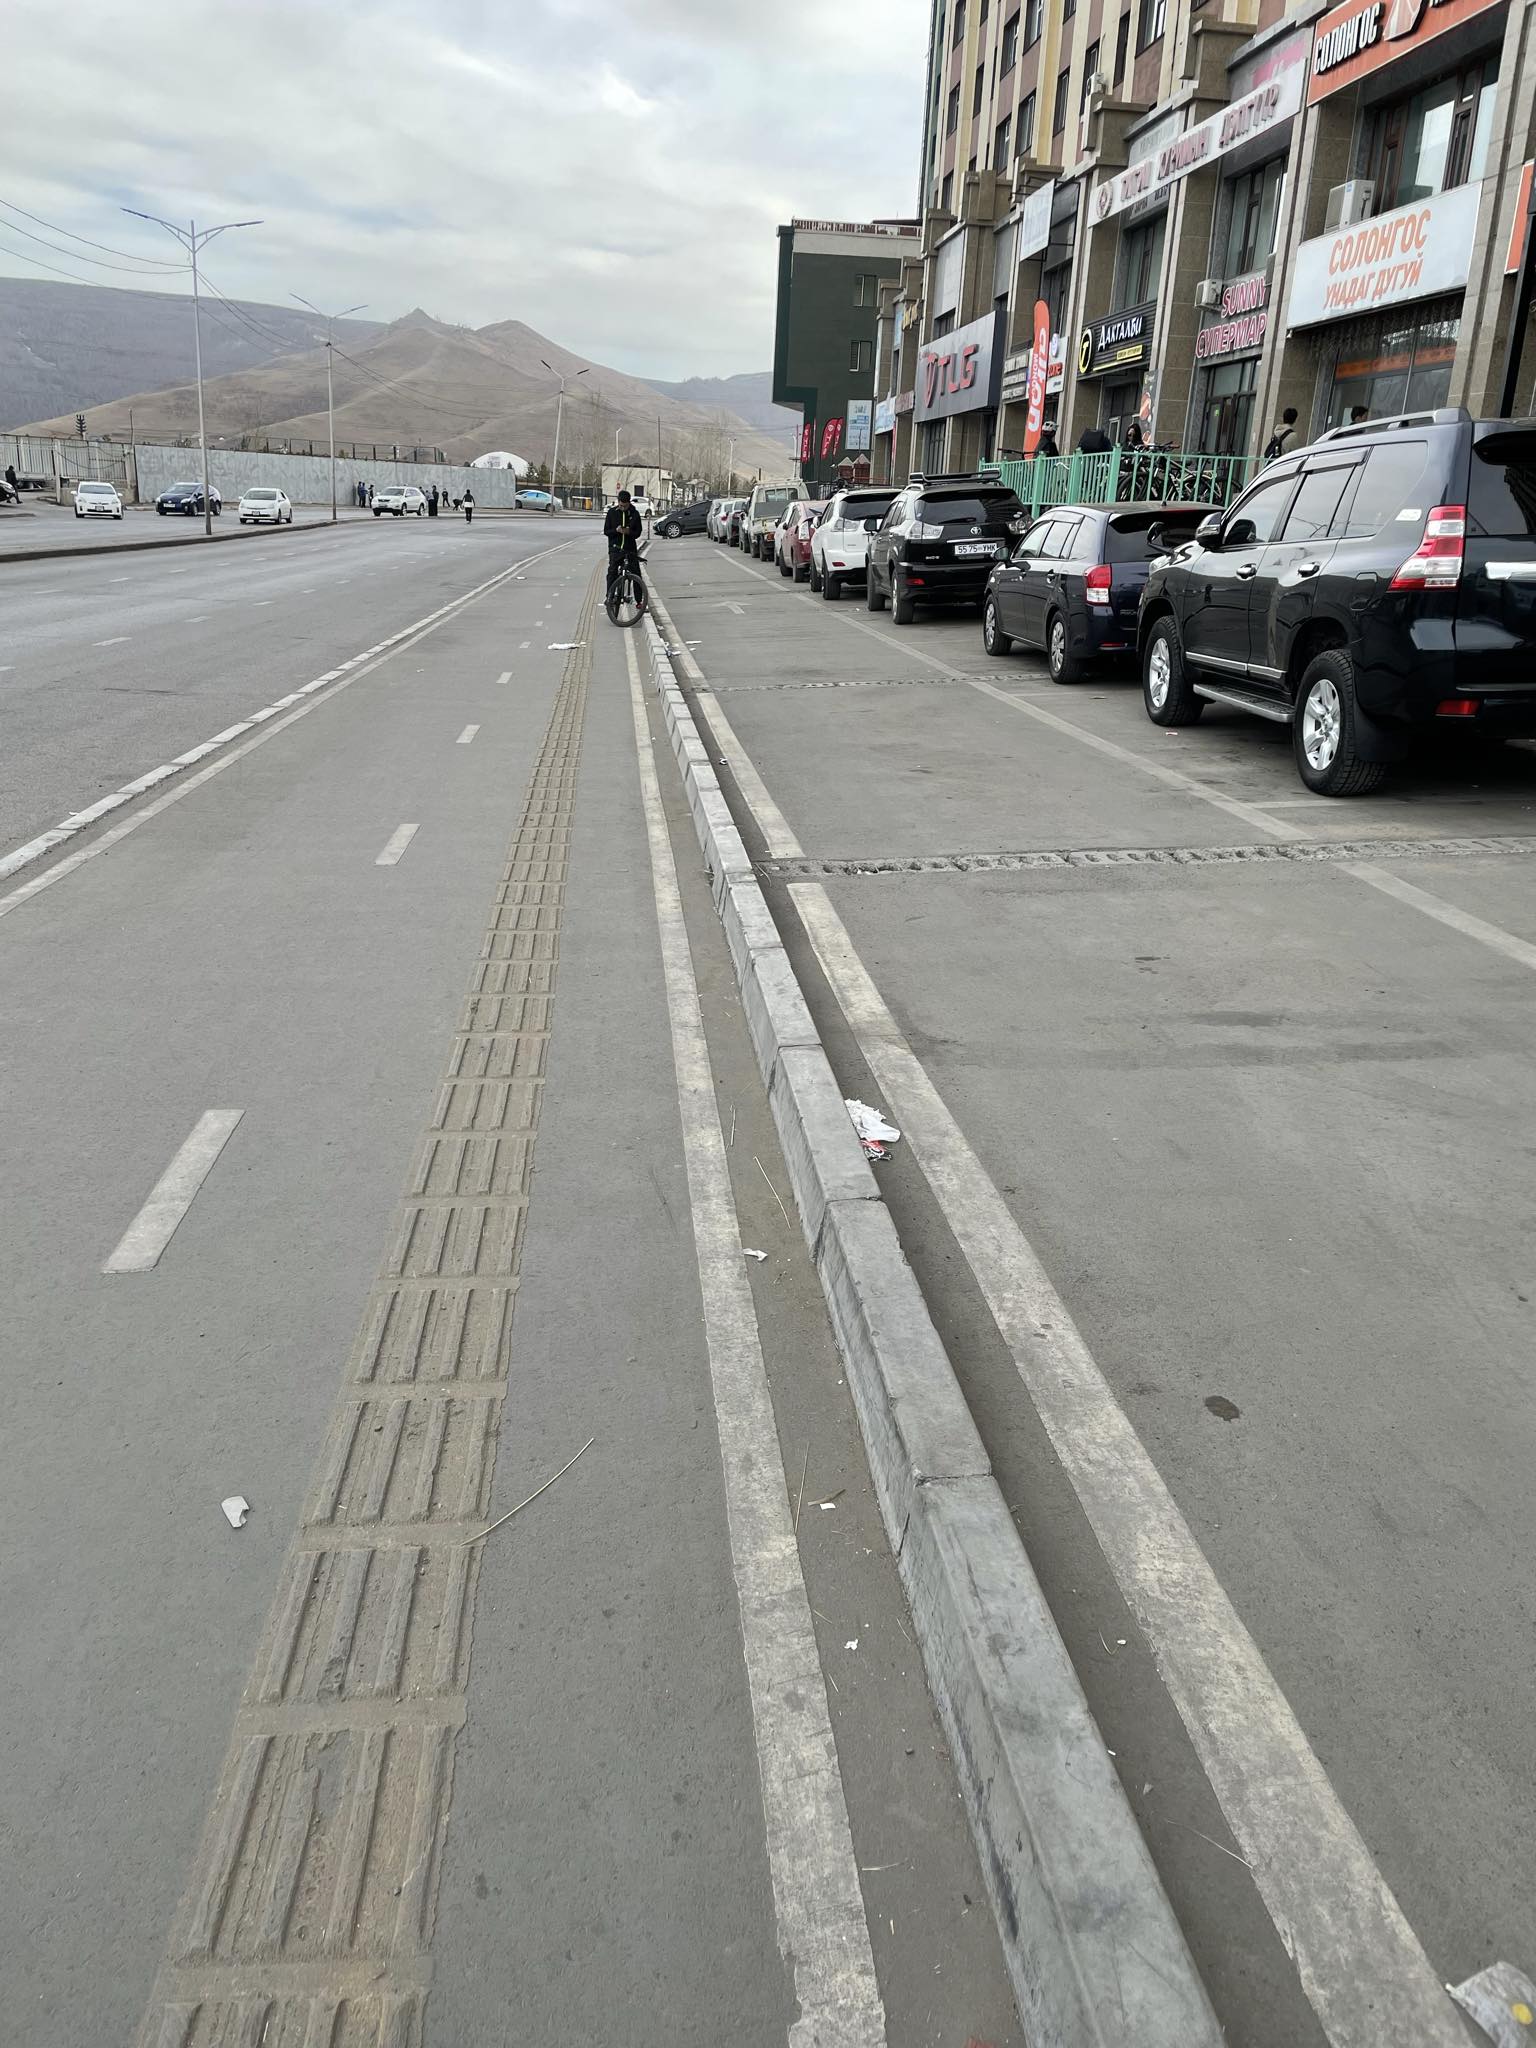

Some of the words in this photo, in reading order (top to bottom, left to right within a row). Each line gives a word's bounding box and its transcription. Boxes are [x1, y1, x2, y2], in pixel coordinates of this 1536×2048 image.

[1313, 2, 1383, 75] СОЛОНГОС
[1328, 209, 1432, 276] СОЛОНГОС
[1221, 276, 1267, 319] SUNNY
[1323, 270, 1376, 310] УНАДАГ
[1371, 252, 1425, 302] ДУГУЙ
[938, 343, 979, 397] TLG
